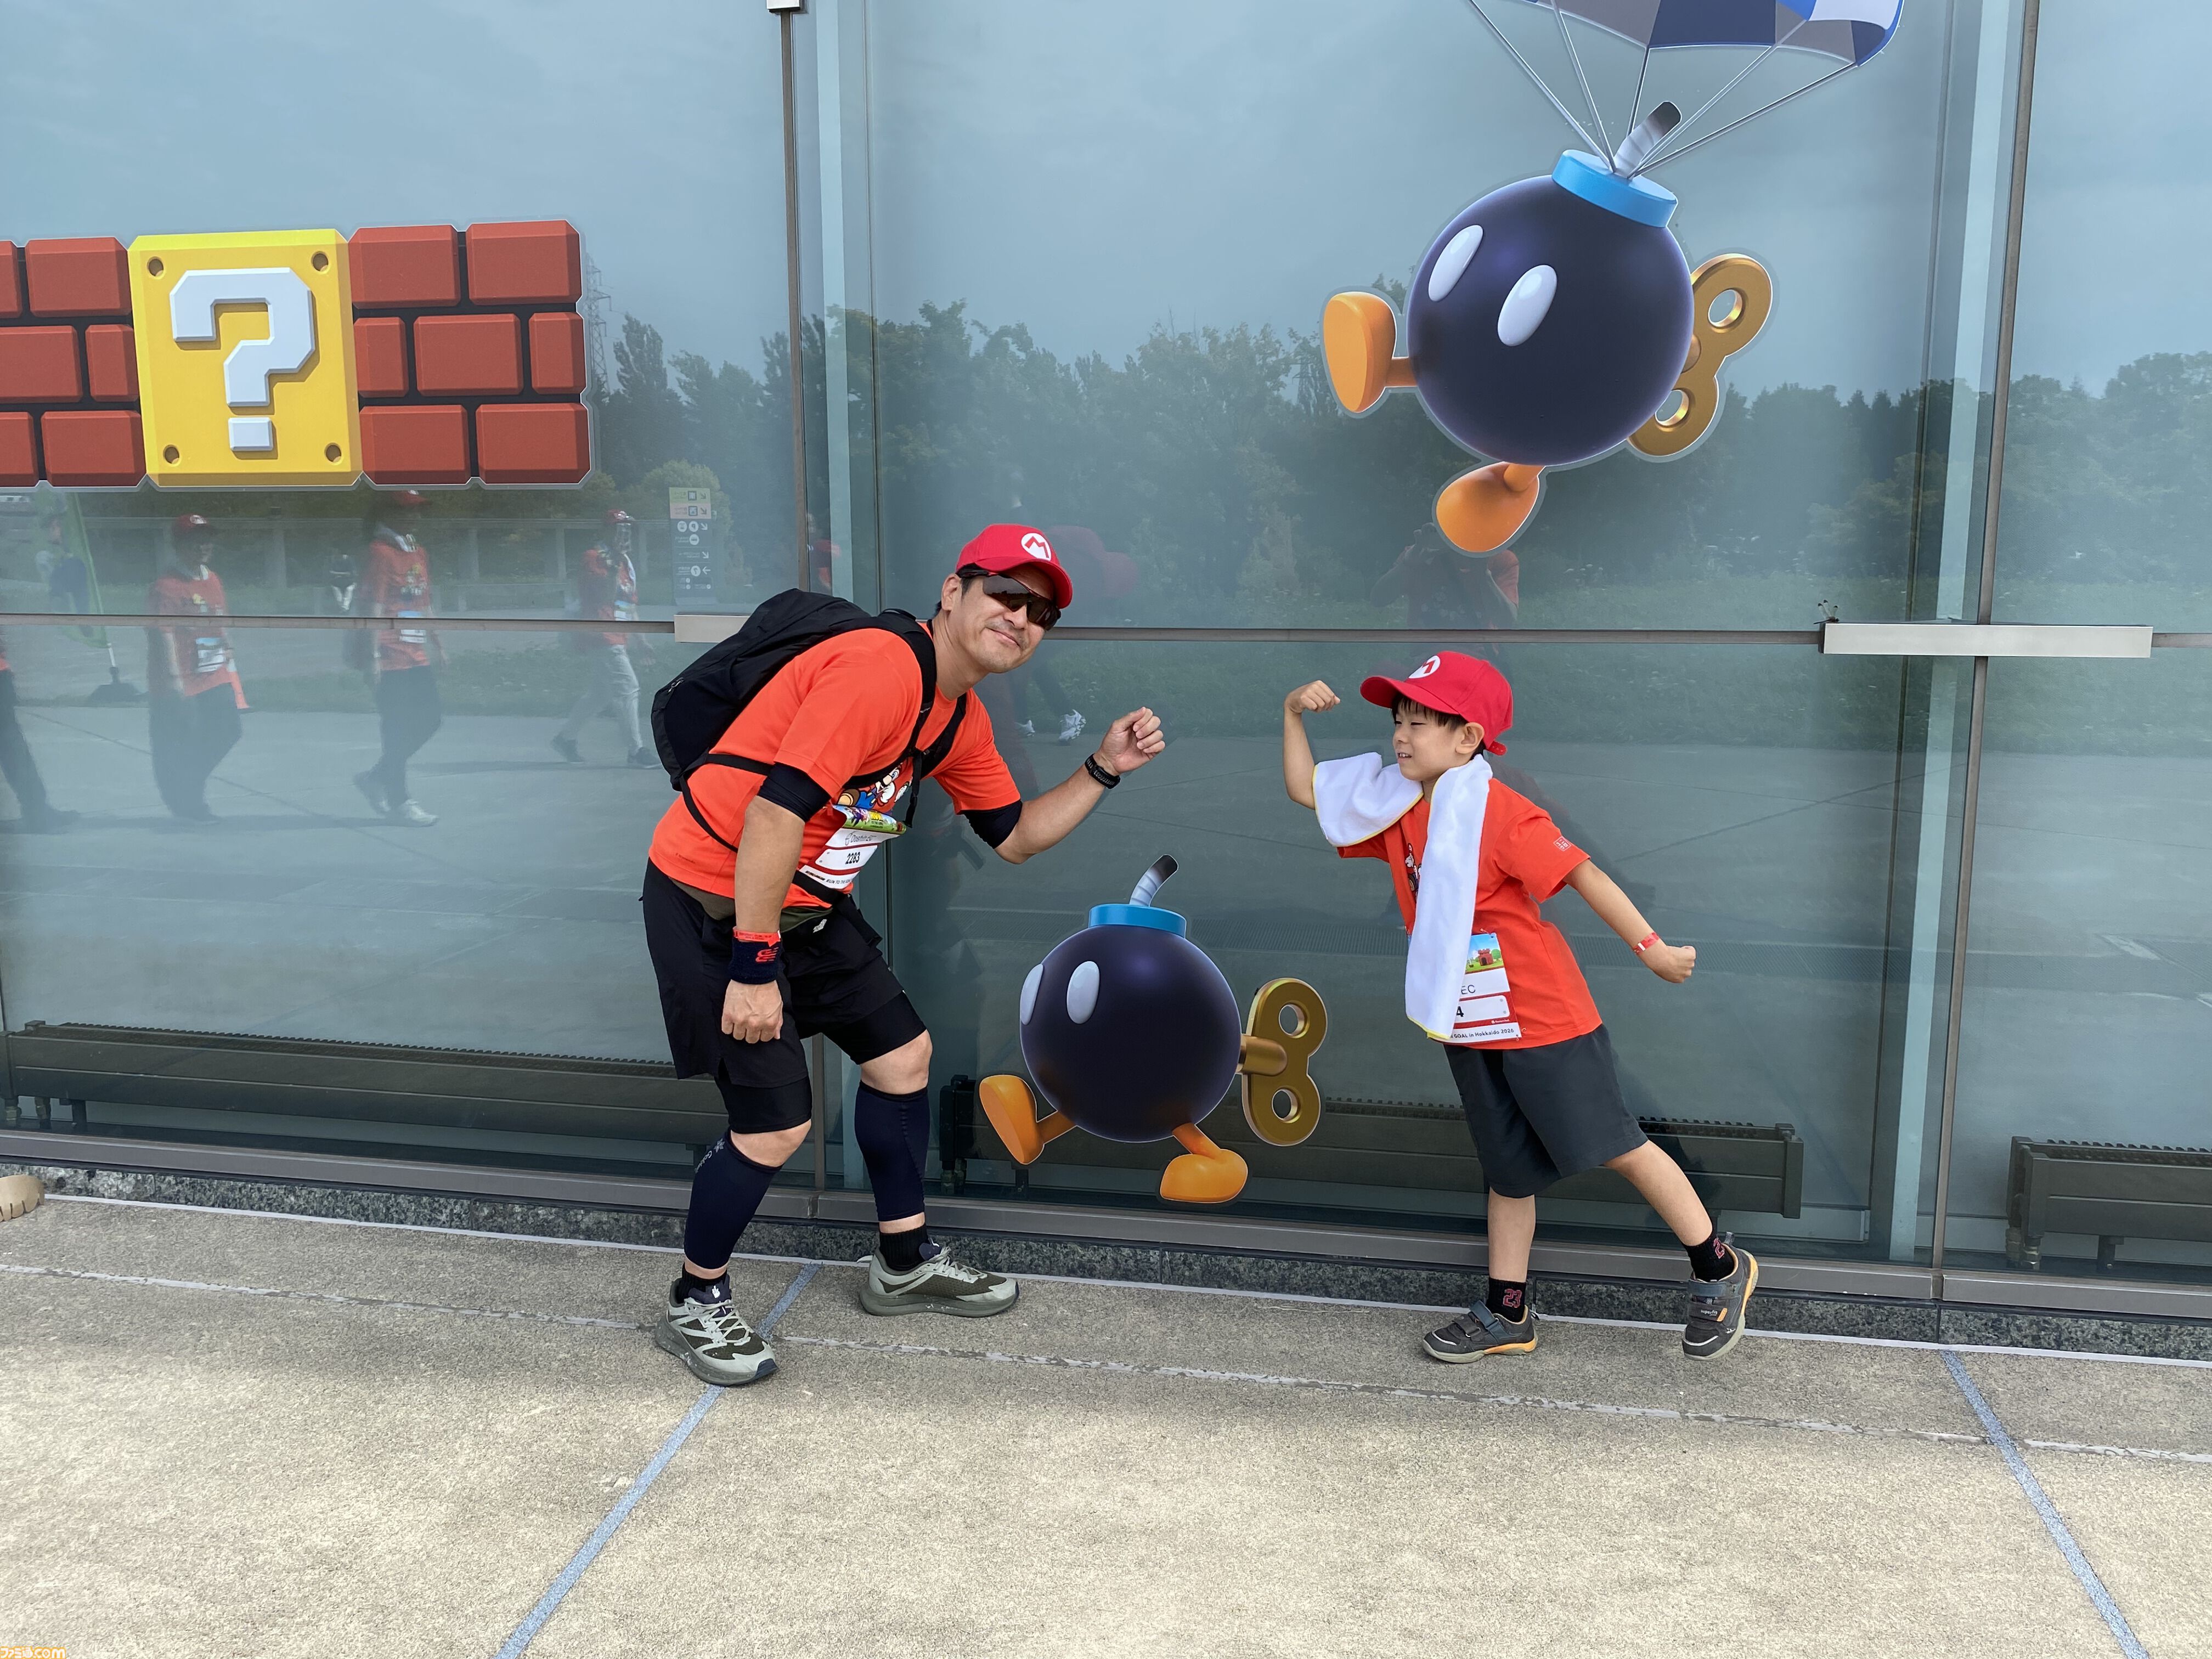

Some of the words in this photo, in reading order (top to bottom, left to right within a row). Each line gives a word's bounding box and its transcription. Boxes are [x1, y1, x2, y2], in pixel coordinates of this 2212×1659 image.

[1024, 535, 1050, 558] M
[845, 851, 861, 865] 2283
[1460, 984, 1476, 995] EC
[1502, 1288, 1523, 1308] 23
